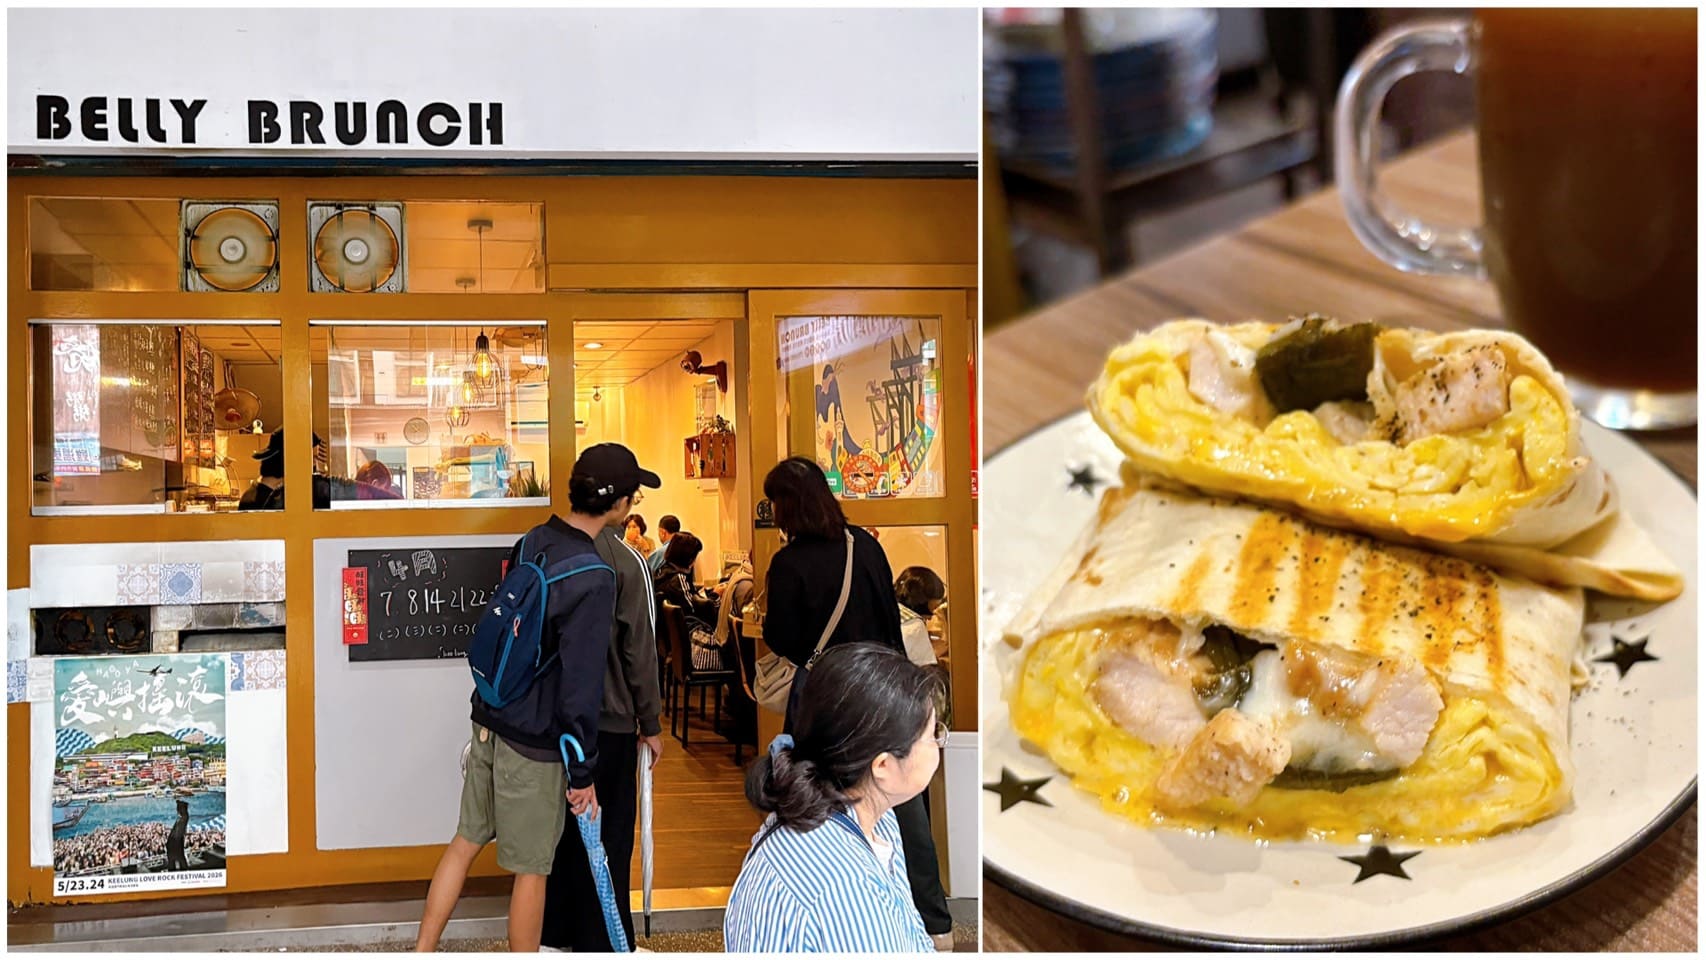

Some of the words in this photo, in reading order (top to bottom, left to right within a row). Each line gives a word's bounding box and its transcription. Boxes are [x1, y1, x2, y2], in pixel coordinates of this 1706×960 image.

[36, 95, 207, 143] BELLY
[248, 100, 504, 146] BRUNCH
[388, 550, 437, 581] 4月
[380, 591, 393, 616] 7
[407, 588, 418, 615] 8
[424, 588, 446, 614] 14
[450, 586, 465, 612] 21
[470, 590, 488, 607] 22
[57, 879, 104, 893] 5/23.24
[107, 876, 138, 885] KEELUNG
[139, 875, 156, 883] LOVE
[157, 873, 176, 882] ROCK
[176, 872, 206, 881] FESTIVAL
